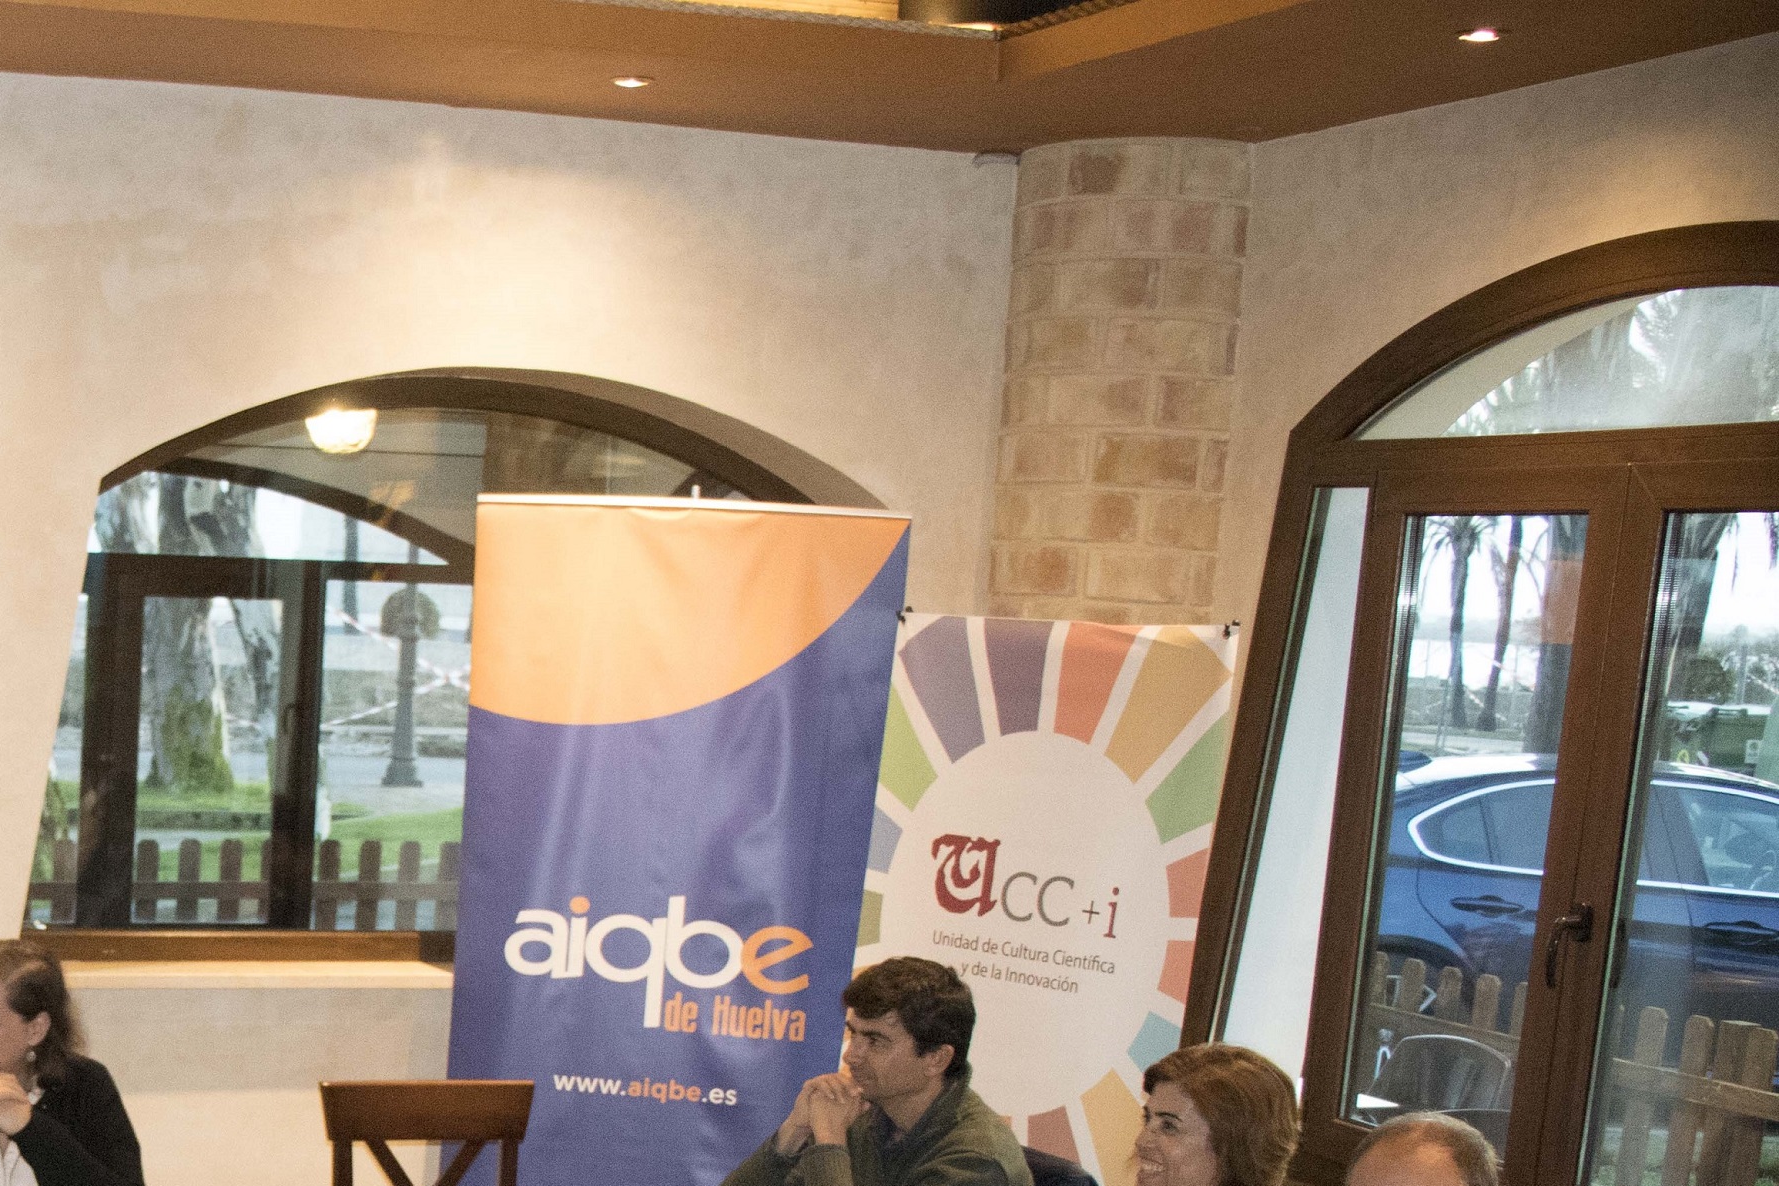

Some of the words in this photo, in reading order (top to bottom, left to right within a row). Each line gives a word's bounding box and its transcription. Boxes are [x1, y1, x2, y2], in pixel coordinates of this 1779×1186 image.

[504, 895, 813, 1028] aiqbe
[932, 930, 979, 952] Unidad
[982, 938, 998, 955] de
[1001, 941, 1049, 963] Cultura
[1052, 949, 1115, 974] Científica
[960, 963, 969, 977] y
[971, 962, 988, 979] de
[991, 963, 1002, 981] la
[1005, 967, 1079, 993] Innovación
[664, 991, 699, 1033] de
[711, 995, 806, 1042] Huelva
[554, 1073, 738, 1106] www.aiqbe.es
